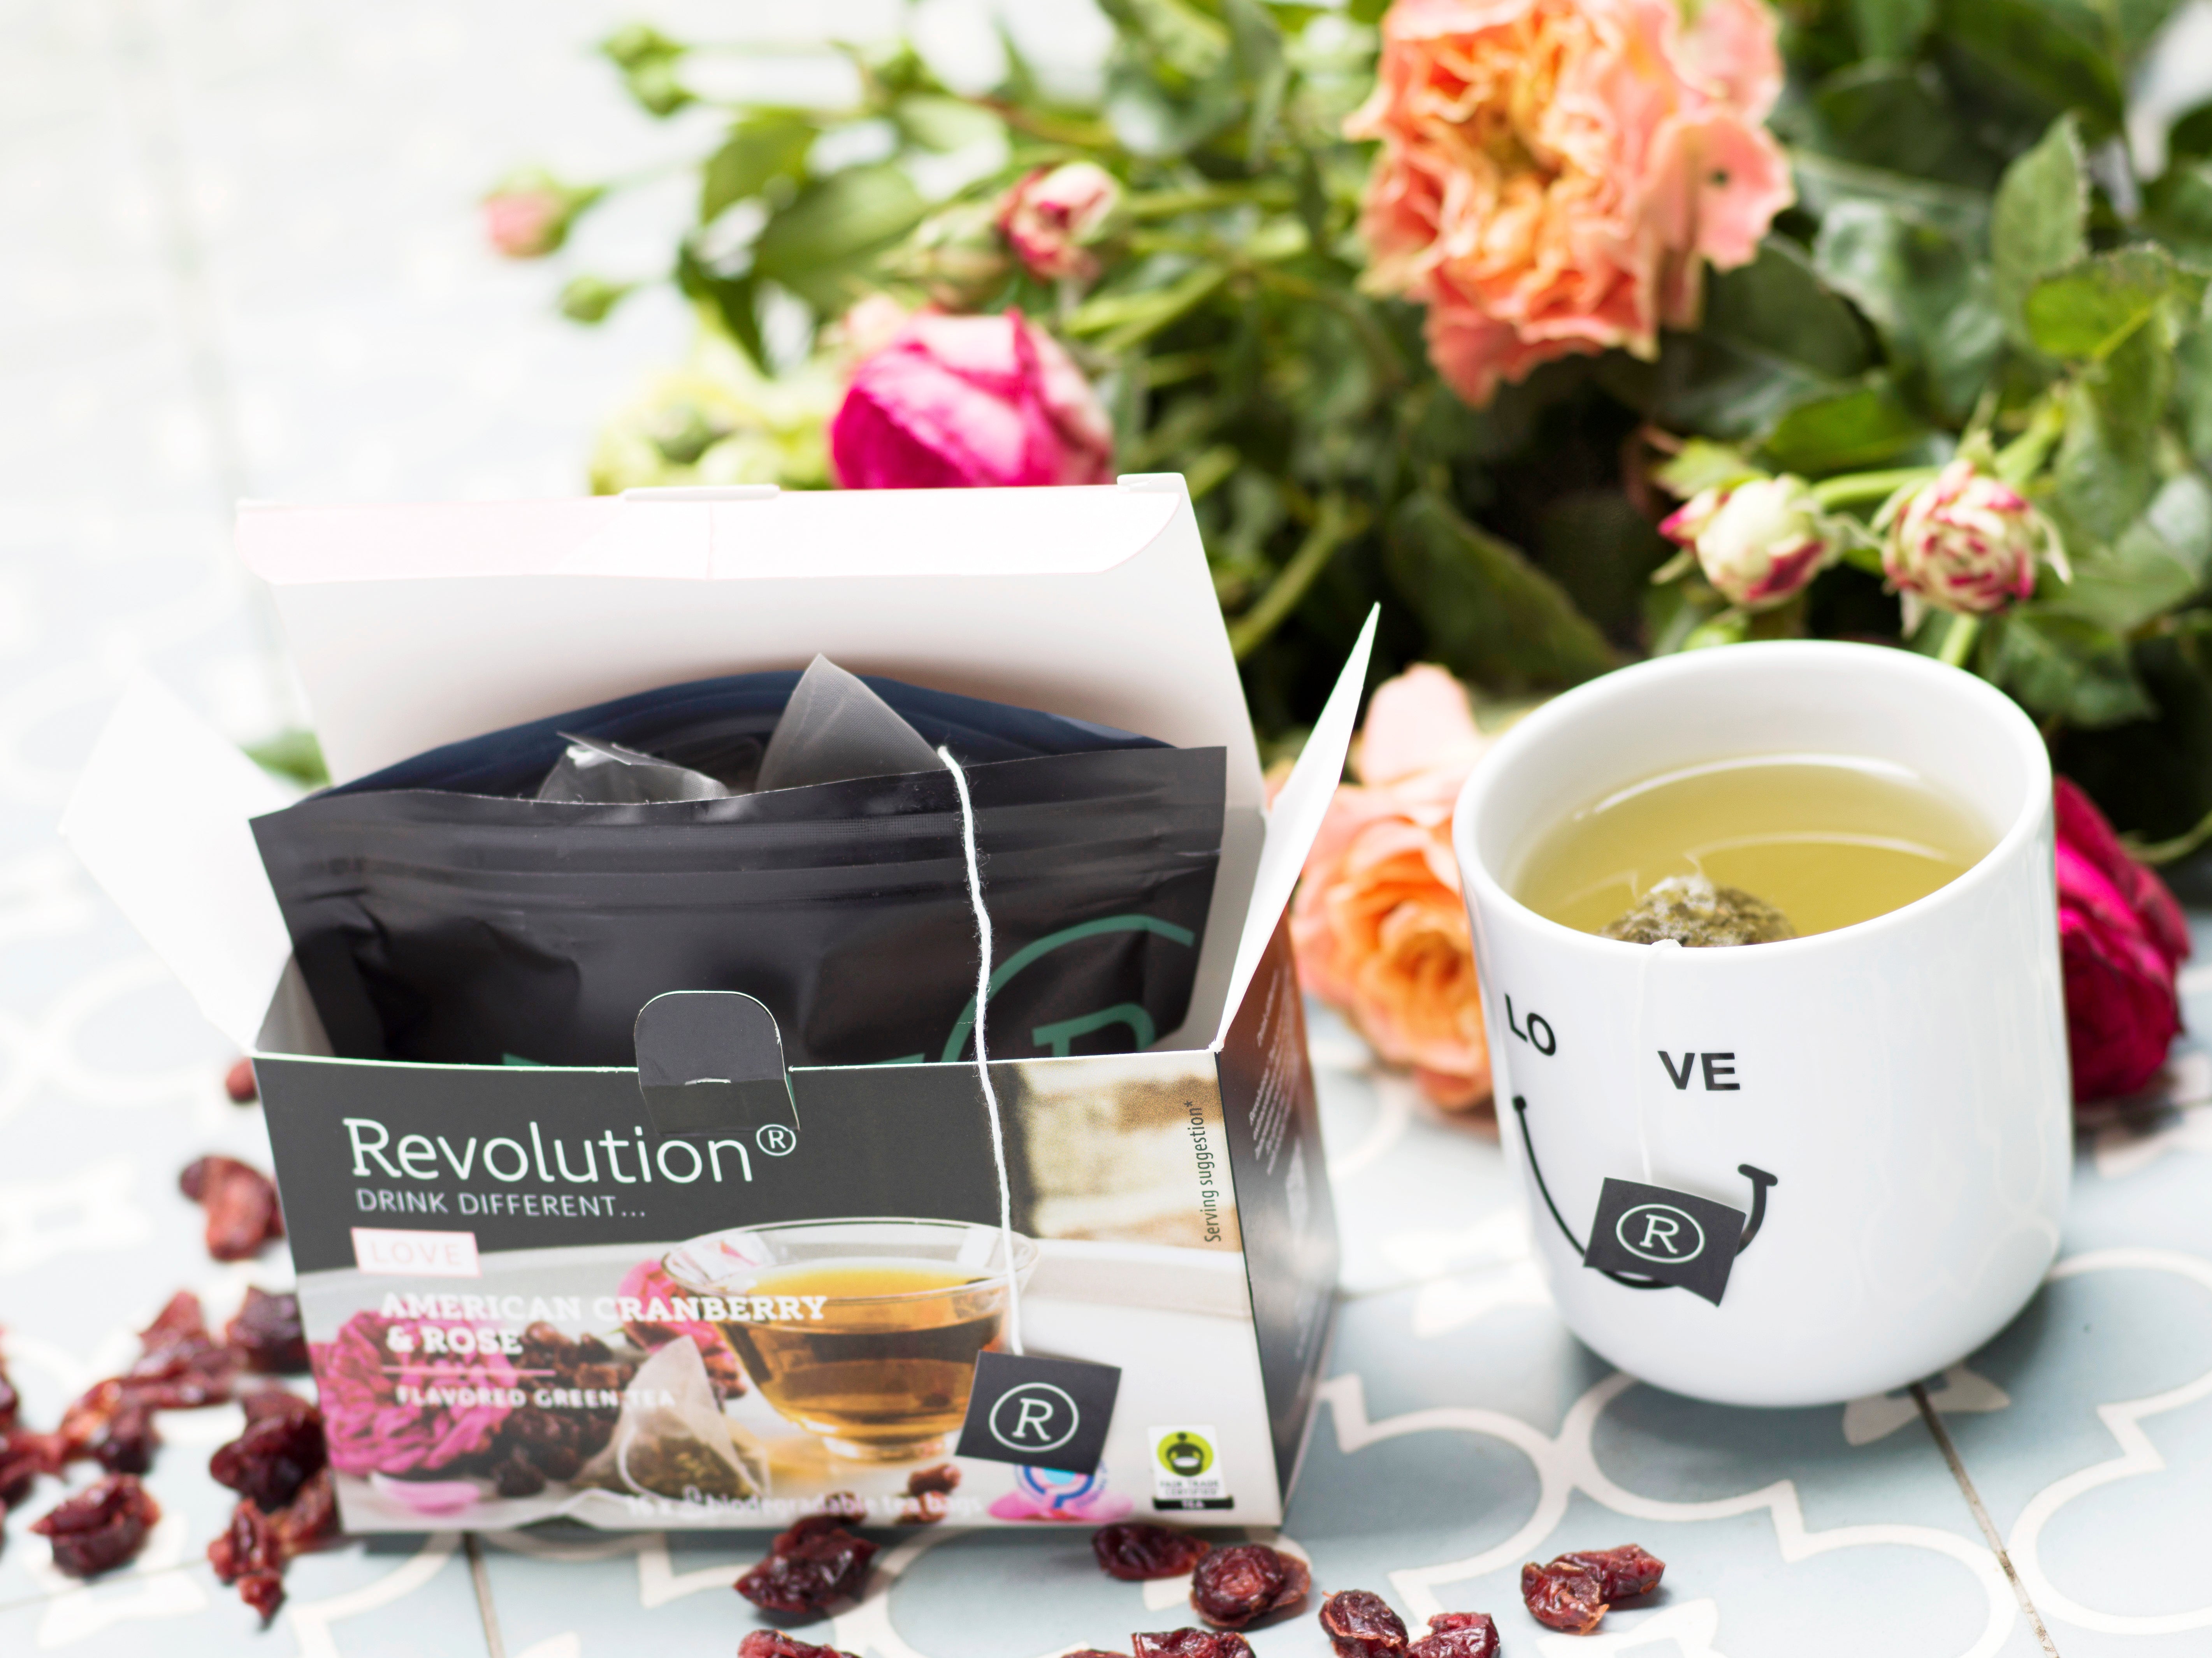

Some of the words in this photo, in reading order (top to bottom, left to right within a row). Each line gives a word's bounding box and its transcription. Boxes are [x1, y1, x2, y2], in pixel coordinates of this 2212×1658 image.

[1505, 993, 1556, 1056] LO
[1657, 1050, 1741, 1091] VE
[355, 1188, 449, 1214] DRINK
[458, 1192, 645, 1217] DIFFERENT...
[1200, 1190, 1221, 1242] Serving
[371, 1242, 462, 1266] LOVE
[381, 1292, 582, 1321] AMERICAN
[593, 1295, 827, 1322] CRANBERRY
[386, 1325, 415, 1353] &
[420, 1326, 523, 1355] ROSE
[395, 1386, 527, 1408] FLAVORED
[533, 1387, 619, 1409] GREEN
[628, 1388, 676, 1407] TEA
[1182, 1500, 1204, 1509] TEA
